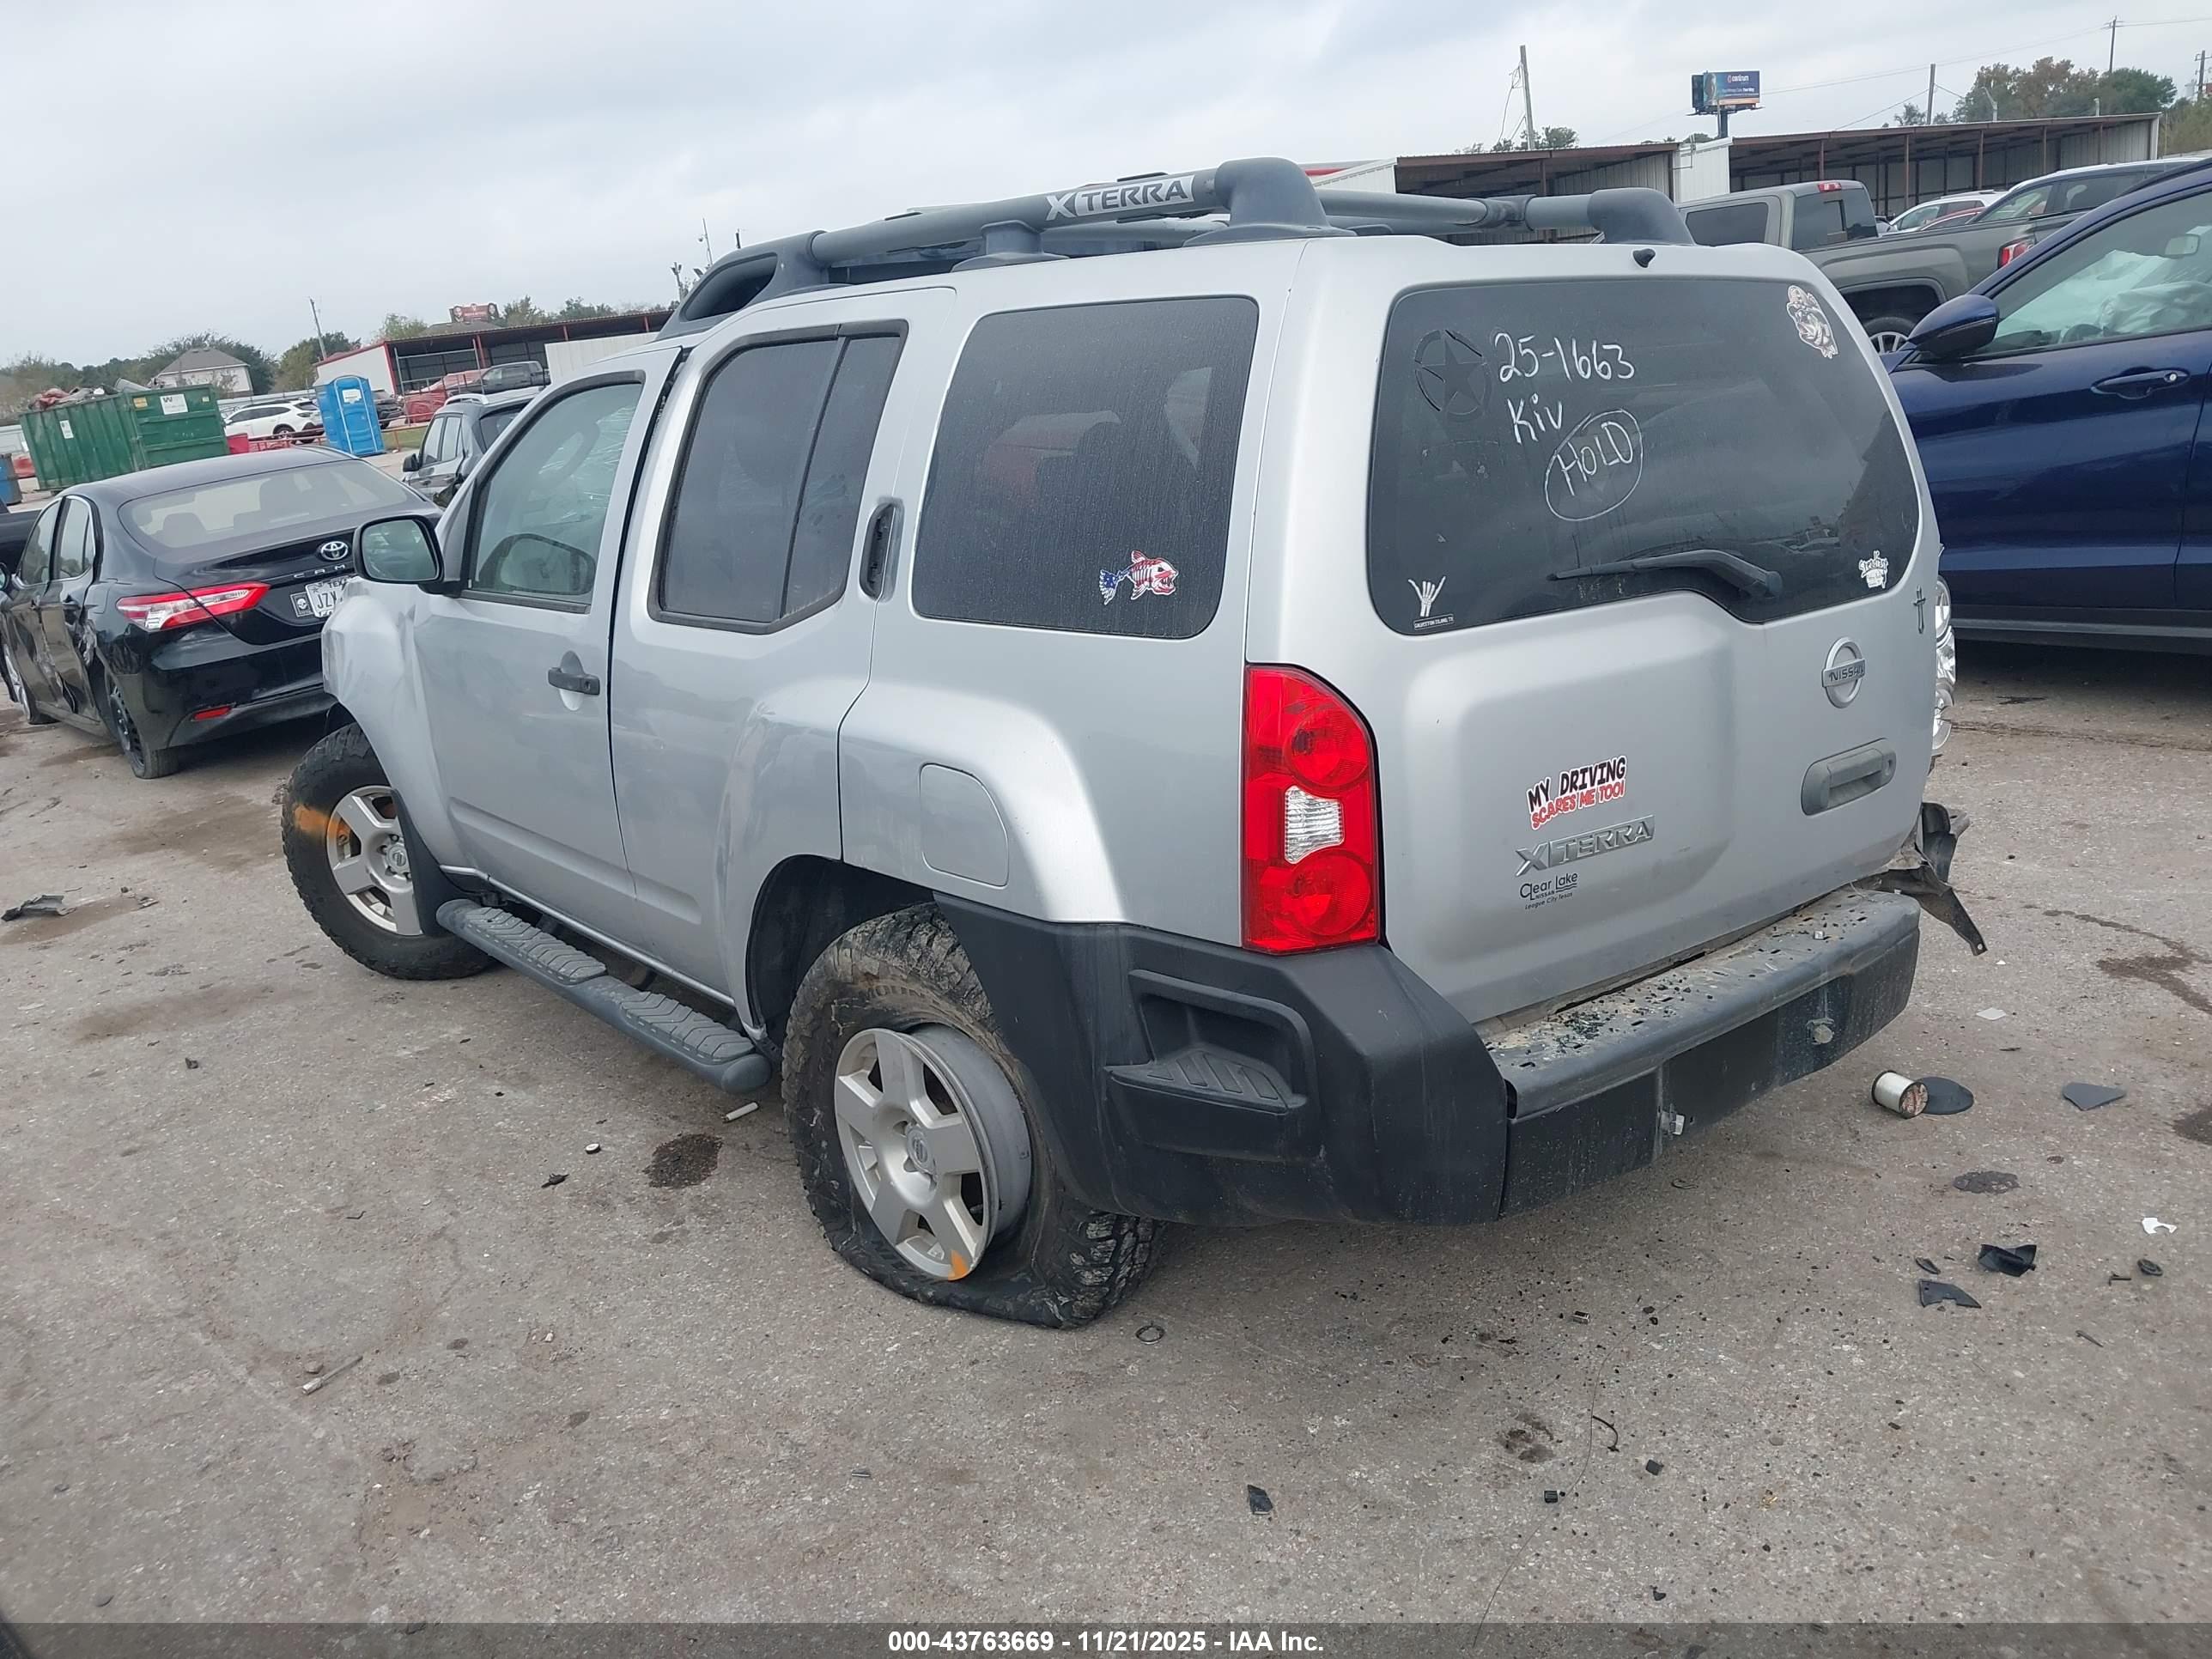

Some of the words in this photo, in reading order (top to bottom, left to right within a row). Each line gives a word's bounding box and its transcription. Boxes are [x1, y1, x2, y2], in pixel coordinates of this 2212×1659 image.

[1045, 179, 1188, 221] XTERRA
[1495, 332, 1635, 382] 25-1663
[294, 564, 345, 579] CAM
[1828, 666, 1863, 682] NISSAN
[1528, 778, 1550, 812] MY
[1559, 757, 1626, 797] DRIVING
[1532, 794, 1577, 829] SCARES
[1579, 788, 1596, 808] ME
[1515, 819, 1654, 878] XTERRA
[1520, 880, 1553, 901] Clear
[1555, 872, 1578, 890] Lake
[1535, 890, 1555, 899] NISSAN
[1546, 896, 1559, 904] City
